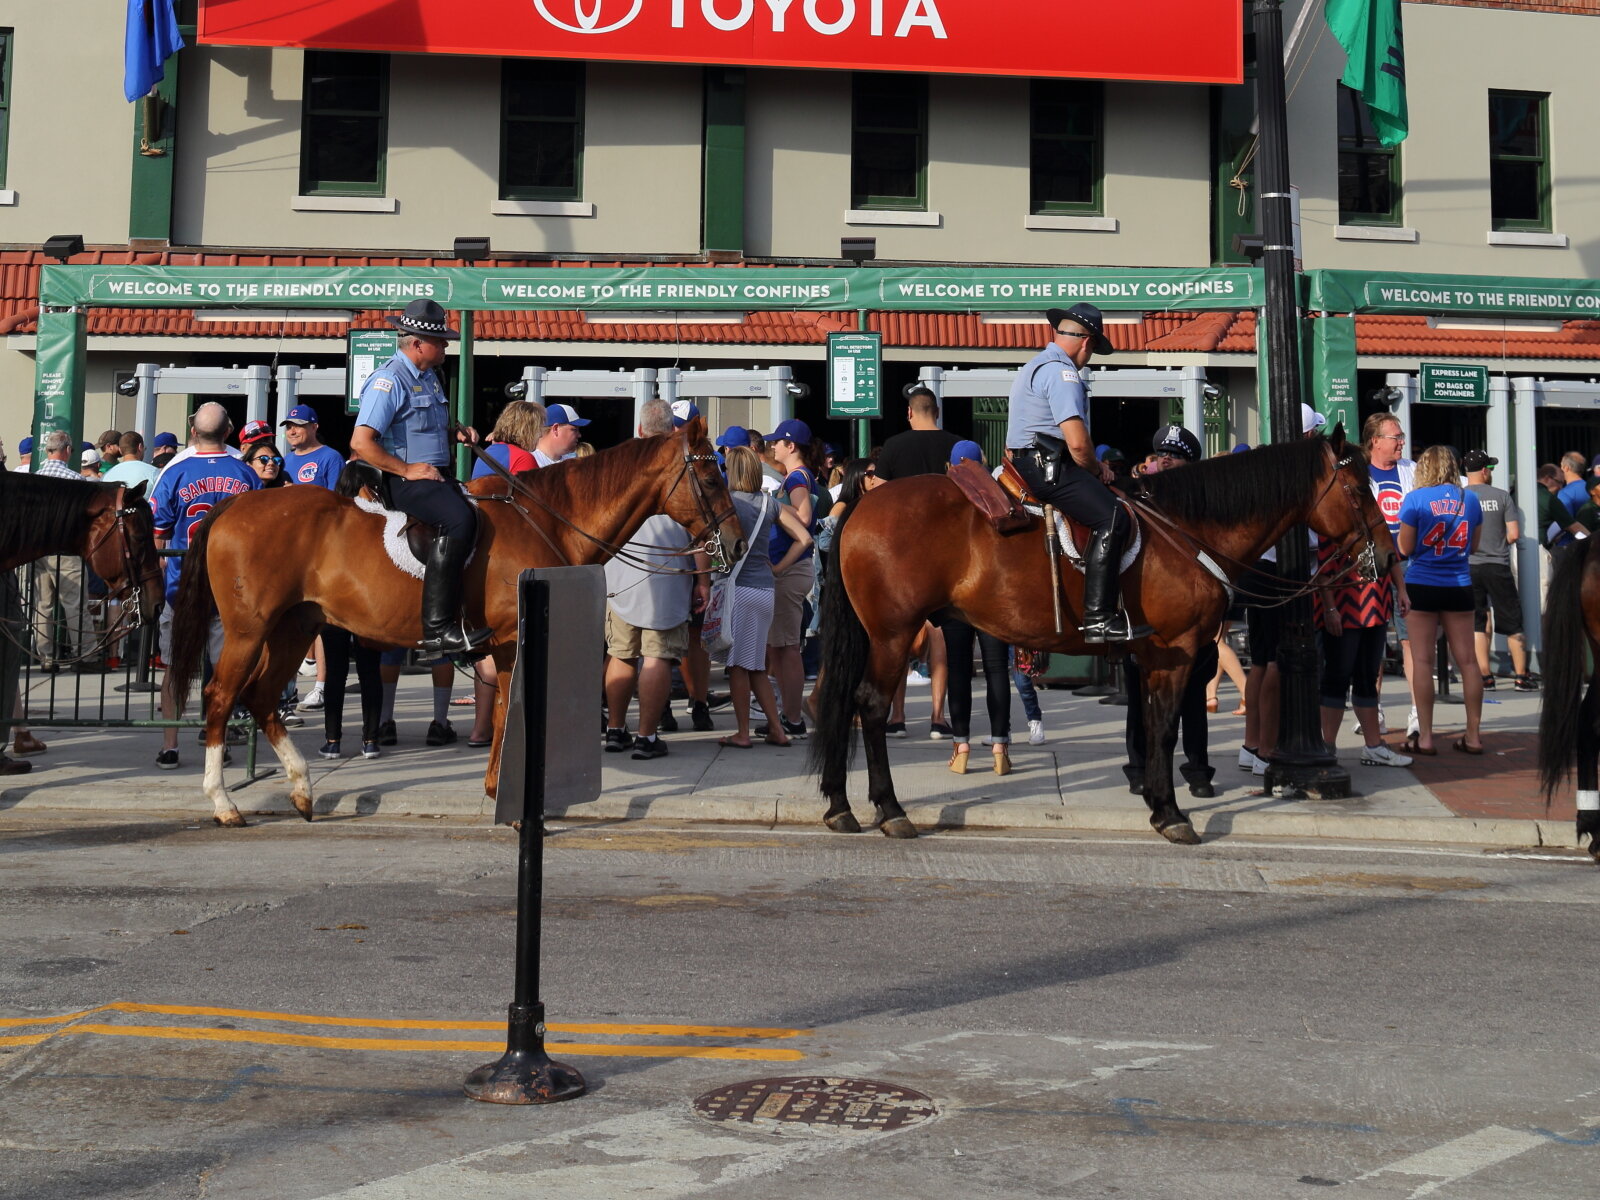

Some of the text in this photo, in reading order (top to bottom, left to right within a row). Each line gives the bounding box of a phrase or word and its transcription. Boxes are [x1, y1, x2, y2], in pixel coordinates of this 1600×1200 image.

[108, 281, 435, 297] WELCOME TO THE FRIENDLY CONFINES
[500, 284, 831, 298] WELCOME TO THE FRIENDLY CONFINES
[898, 280, 1234, 298] WELCOME TO THE FRIENDLY CONFINES
[1381, 288, 1451, 304] WELCOME
[1454, 291, 1474, 305] TO
[1477, 292, 1504, 306] THE
[1508, 293, 1572, 308] FRIENDLY
[1431, 369, 1478, 378] EXPRESS LANE
[1433, 389, 1475, 398] CONTAINERS
[1446, 382, 1463, 390] BAGS
[1423, 521, 1468, 556] 44
